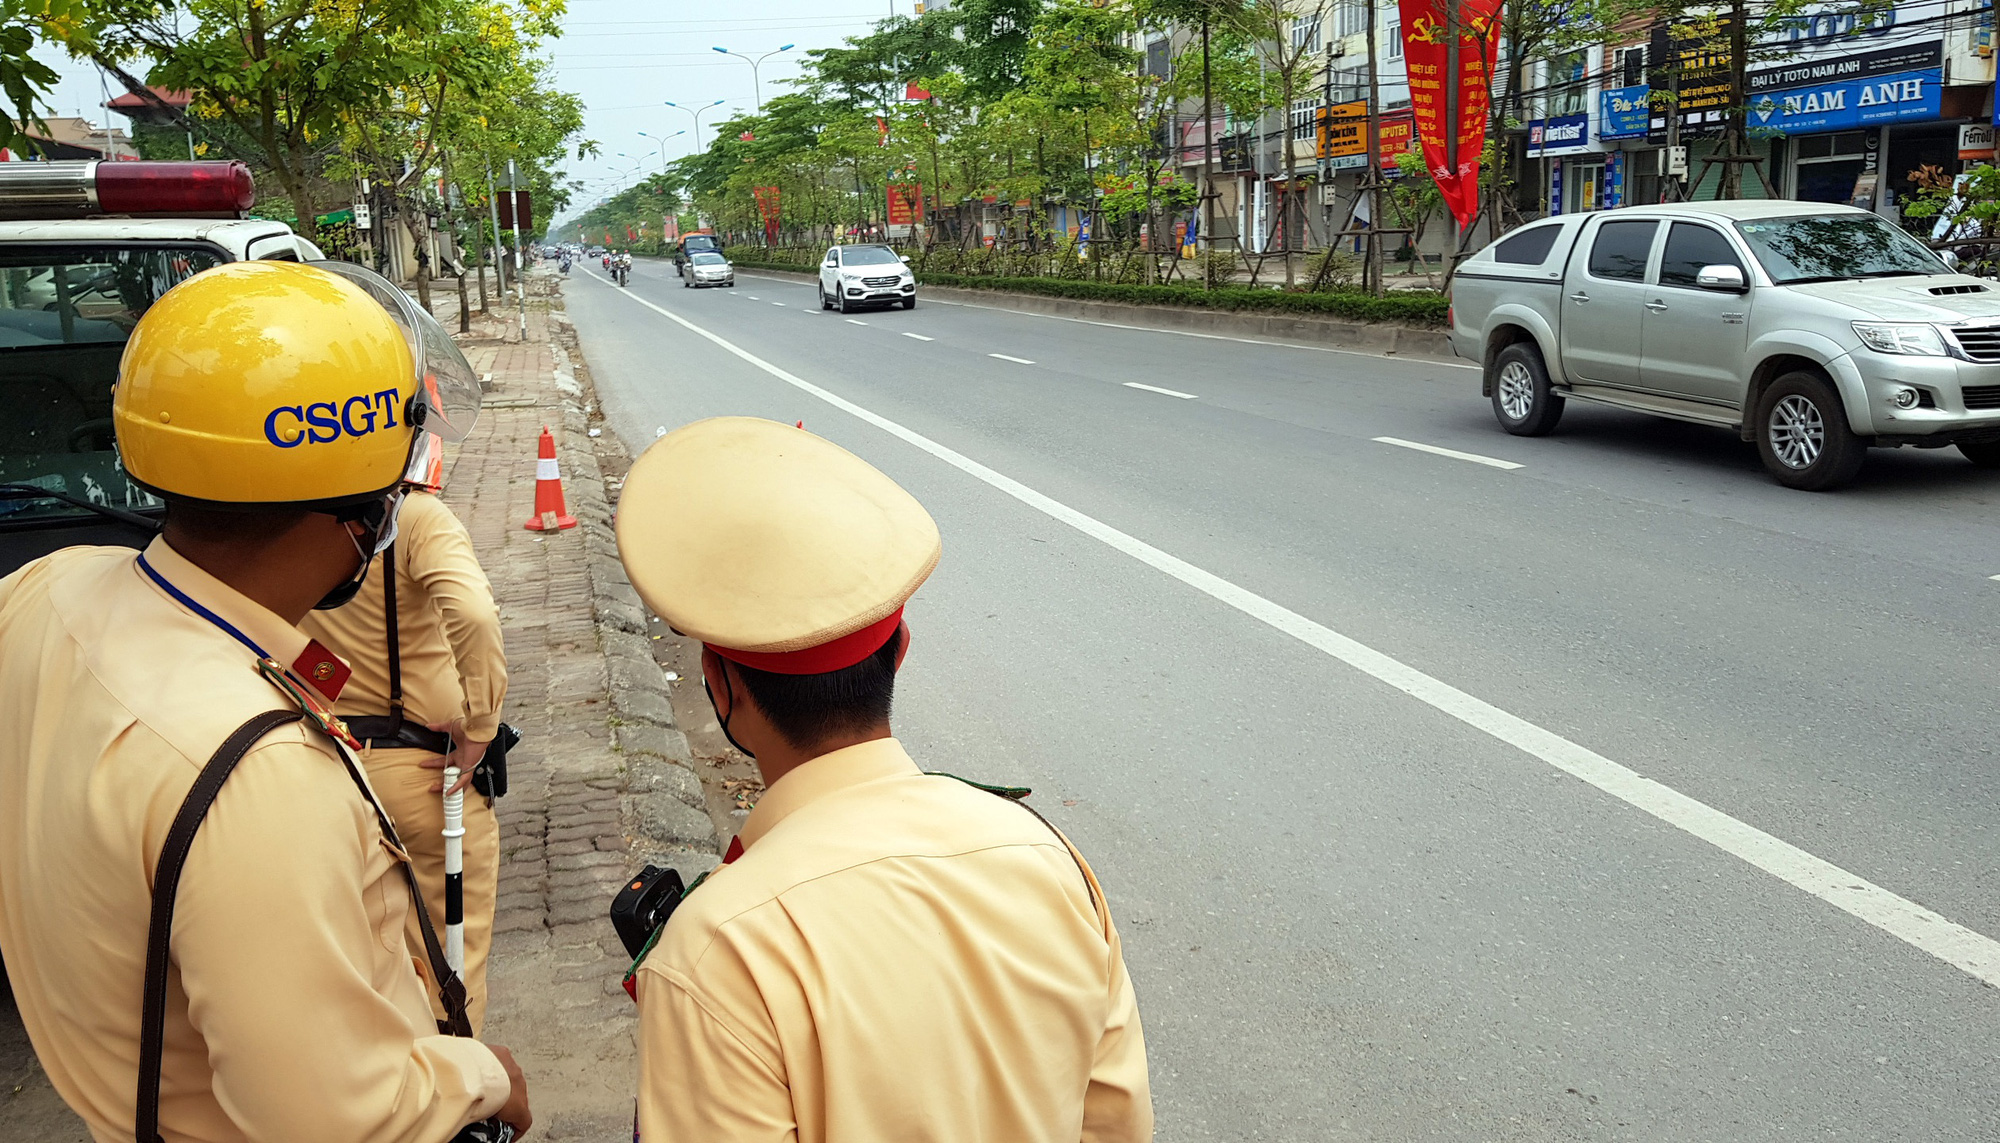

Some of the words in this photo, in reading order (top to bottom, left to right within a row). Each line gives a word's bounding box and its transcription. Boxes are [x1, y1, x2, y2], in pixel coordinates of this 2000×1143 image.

[1751, 75, 1768, 89] ĐẠI
[1784, 68, 1810, 82] TOTO
[1811, 64, 1836, 78] NAM
[1837, 60, 1861, 75] ANH
[1782, 89, 1846, 116] NAM
[1857, 78, 1925, 107] ANH
[1379, 124, 1408, 139] MPUTER
[264, 388, 400, 449] CSGT
